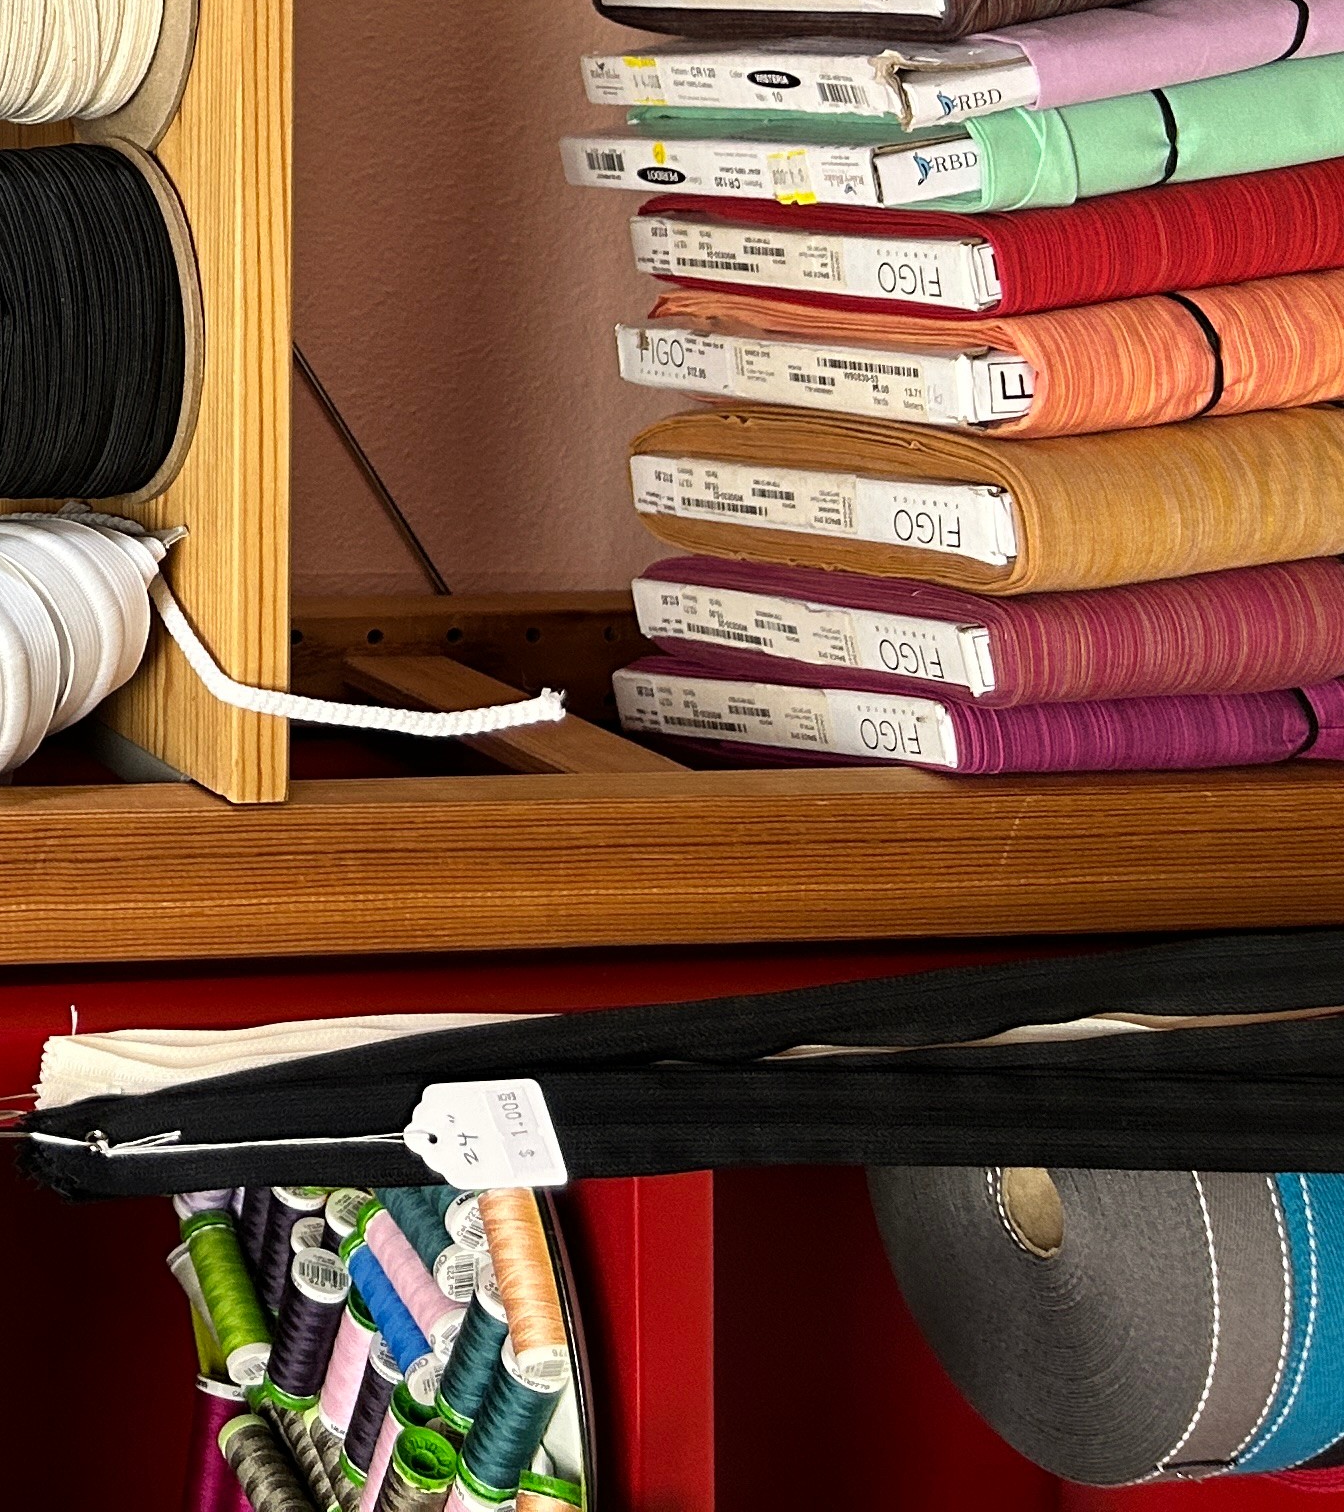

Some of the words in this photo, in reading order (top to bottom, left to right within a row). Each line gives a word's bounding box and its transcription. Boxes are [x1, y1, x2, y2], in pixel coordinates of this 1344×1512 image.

[771, 90, 784, 103] 10
[957, 86, 1004, 114] RBD
[932, 149, 980, 176] RBD
[876, 260, 943, 299] FIGO
[892, 509, 963, 550] FIGO
[878, 638, 946, 680] FIGO
[858, 717, 923, 756] FIGO
[501, 1101, 529, 1138] 1.00
[464, 1206, 481, 1222] 223
[446, 1264, 455, 1281] 223
